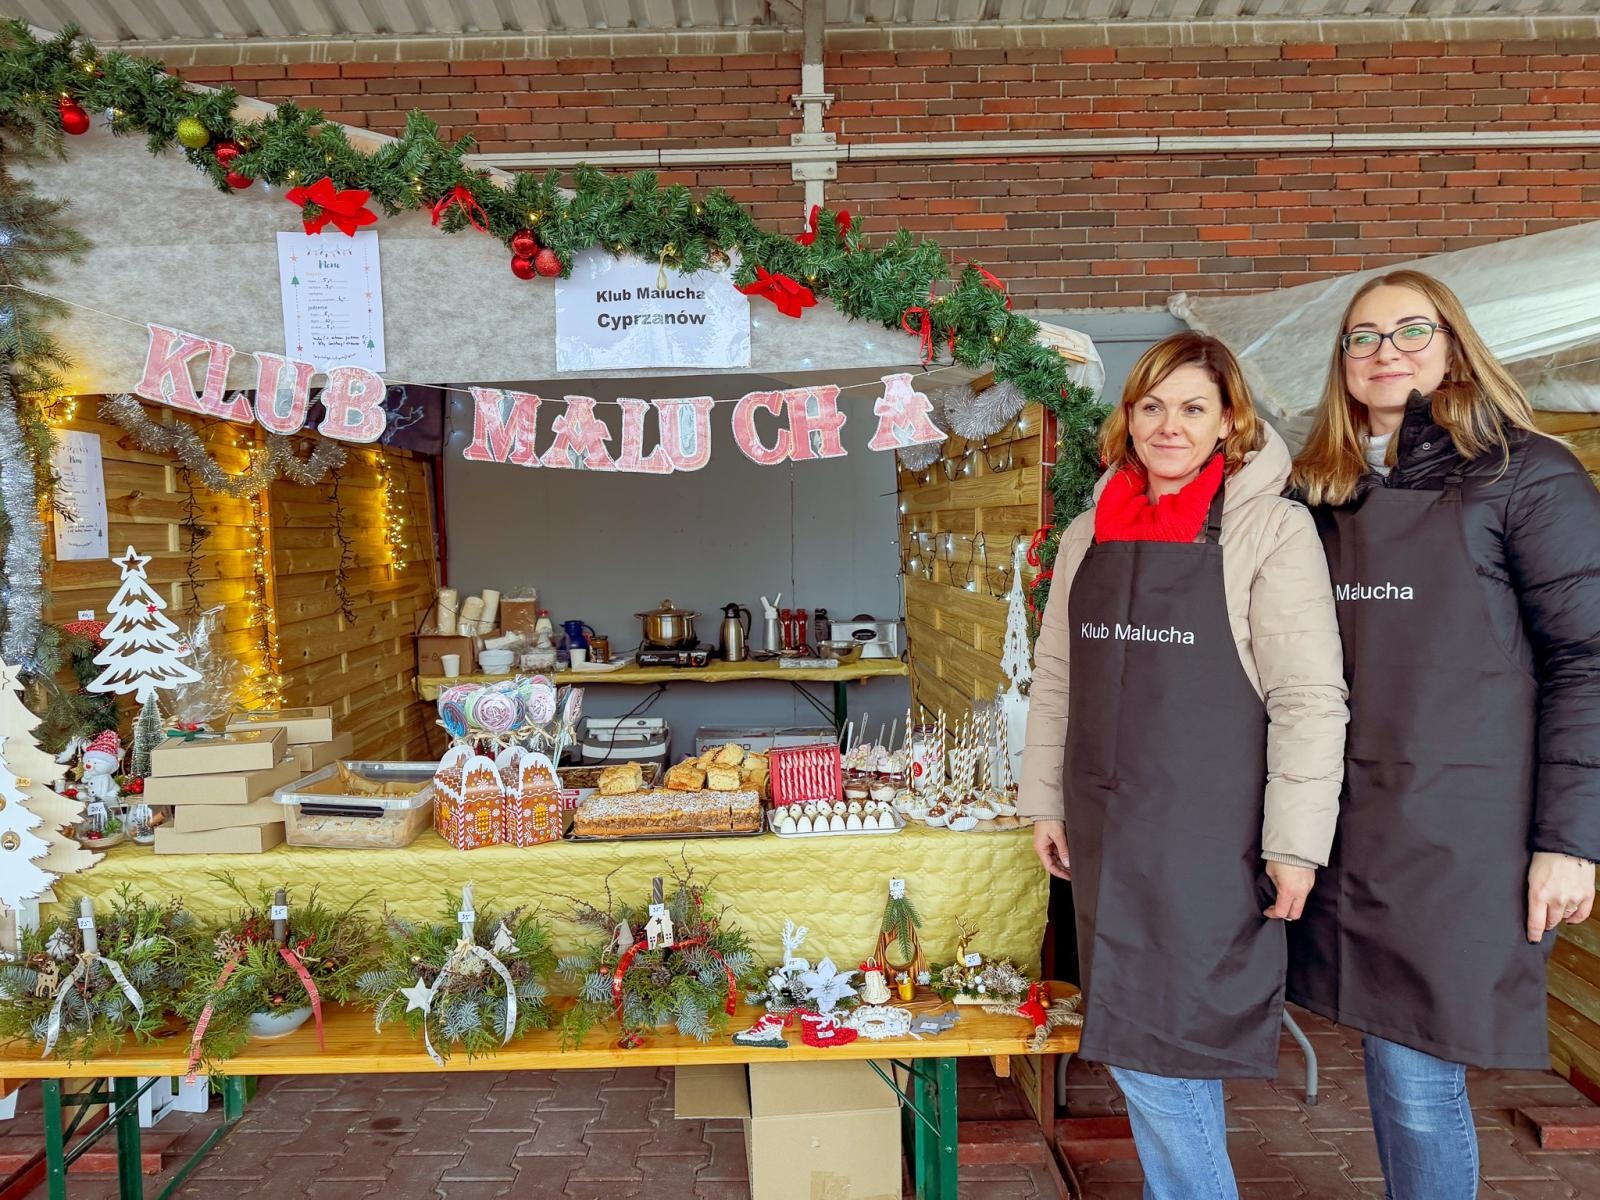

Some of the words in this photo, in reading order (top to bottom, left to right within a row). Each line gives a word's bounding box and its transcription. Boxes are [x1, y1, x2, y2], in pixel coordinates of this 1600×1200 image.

[596, 289, 632, 303] Klub
[636, 287, 706, 300] Malucha
[597, 310, 706, 330] Cyprzanów
[134, 323, 387, 444] KLUB
[463, 373, 949, 475] MALUCHA
[1335, 582, 1414, 601] Malucha
[1080, 622, 1110, 640] Klub
[1114, 623, 1195, 646] Malucha
